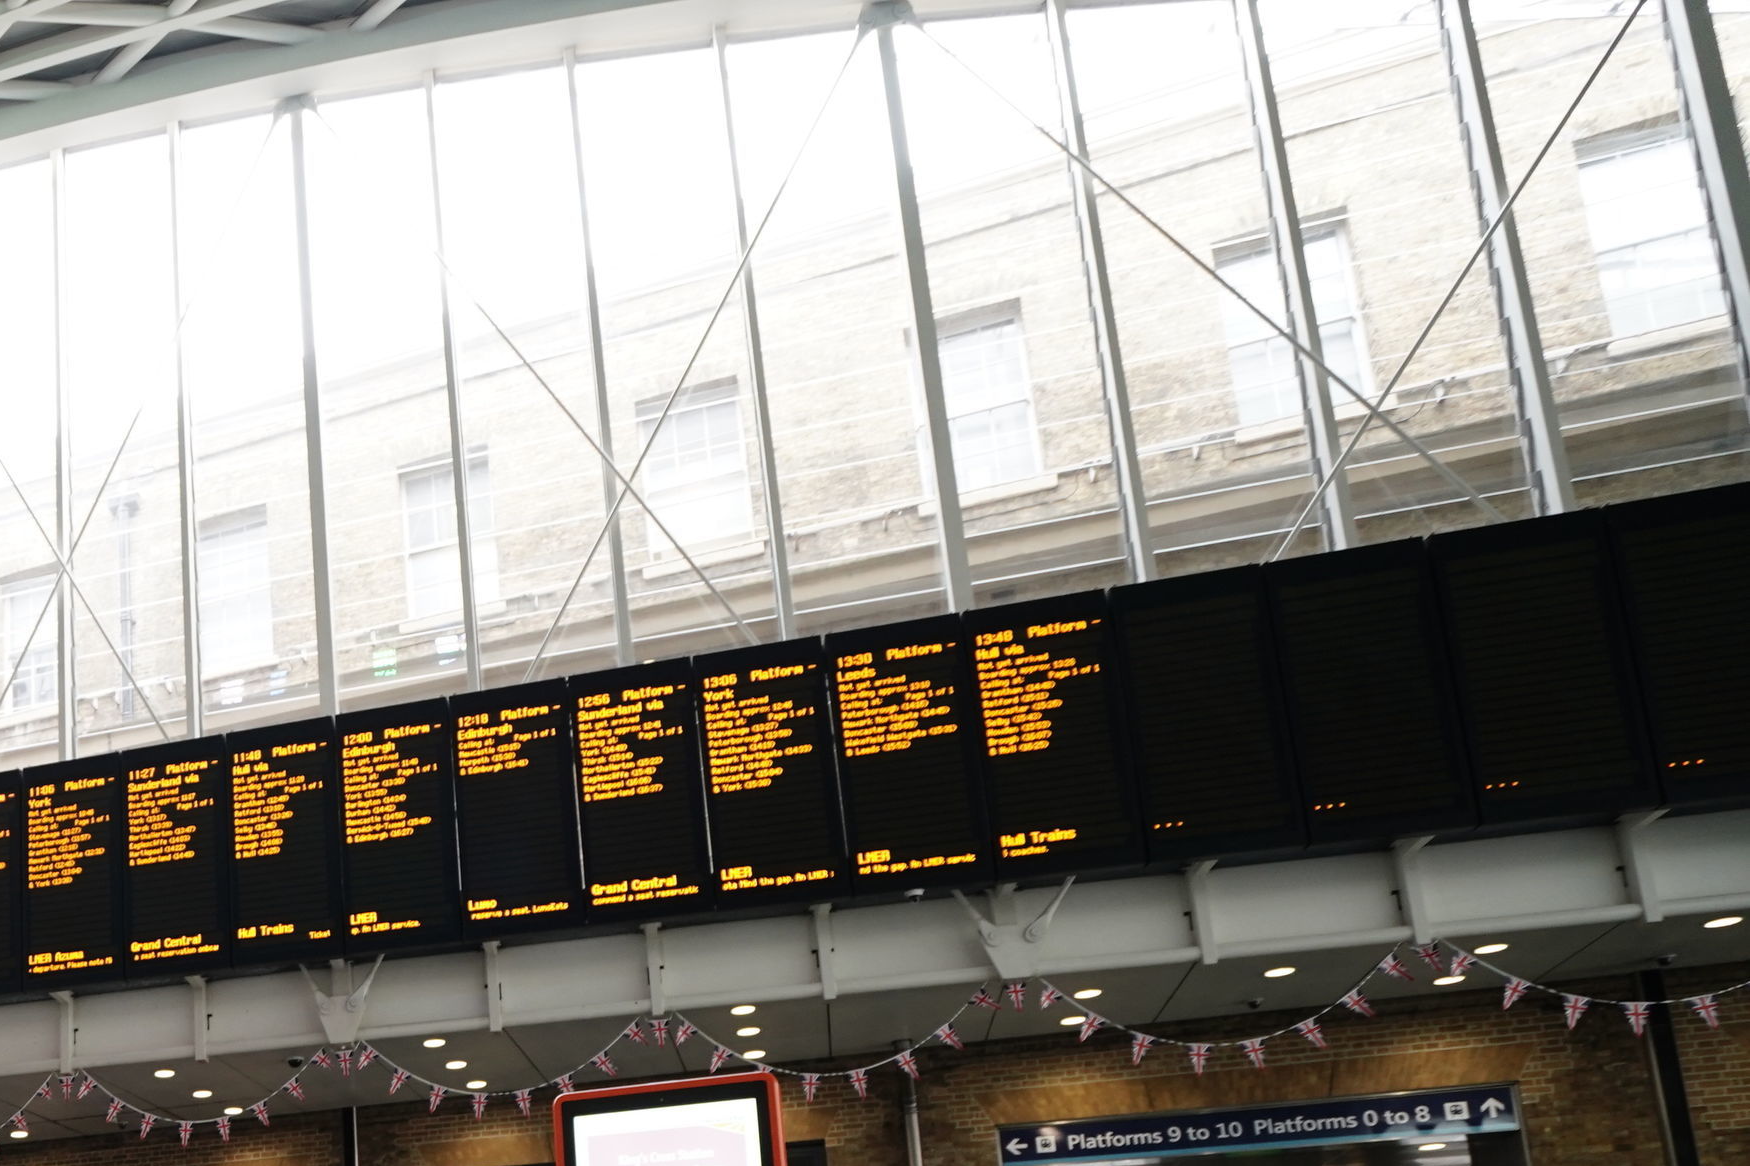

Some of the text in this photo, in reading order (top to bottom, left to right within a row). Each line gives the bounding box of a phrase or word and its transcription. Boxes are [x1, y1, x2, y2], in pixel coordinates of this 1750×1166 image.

[1026, 620, 1088, 639] Platform
[885, 643, 943, 661] Platform
[974, 643, 1025, 661] Hull via
[749, 664, 804, 682] Platform
[836, 666, 877, 683] Leeds
[621, 685, 674, 702] Platform
[702, 687, 735, 703] York
[499, 705, 550, 722] Platform
[576, 698, 665, 723] Sunderland via
[383, 723, 431, 740] Platform
[456, 722, 513, 742] Edinburgh
[271, 742, 317, 758] Platform
[341, 740, 396, 760] Edinburgh
[165, 760, 209, 775] Platform
[232, 761, 269, 777] Hull via
[64, 777, 106, 792] Platform
[127, 772, 200, 794] Sunderland via
[27, 796, 52, 810] York
[999, 828, 1077, 848] Hull Trains
[856, 849, 891, 866] LNER
[720, 865, 753, 882] LNER
[590, 874, 678, 897] Grand Central
[467, 898, 498, 912] Lumo
[349, 911, 378, 926] LNER
[237, 923, 295, 940] Hull Trains
[130, 933, 202, 953] Grand Central
[28, 950, 85, 966] LNER Azuma
[1253, 1105, 1431, 1136] Platforms 0 to 8
[1067, 1121, 1243, 1151] Platforms 9 to 10
